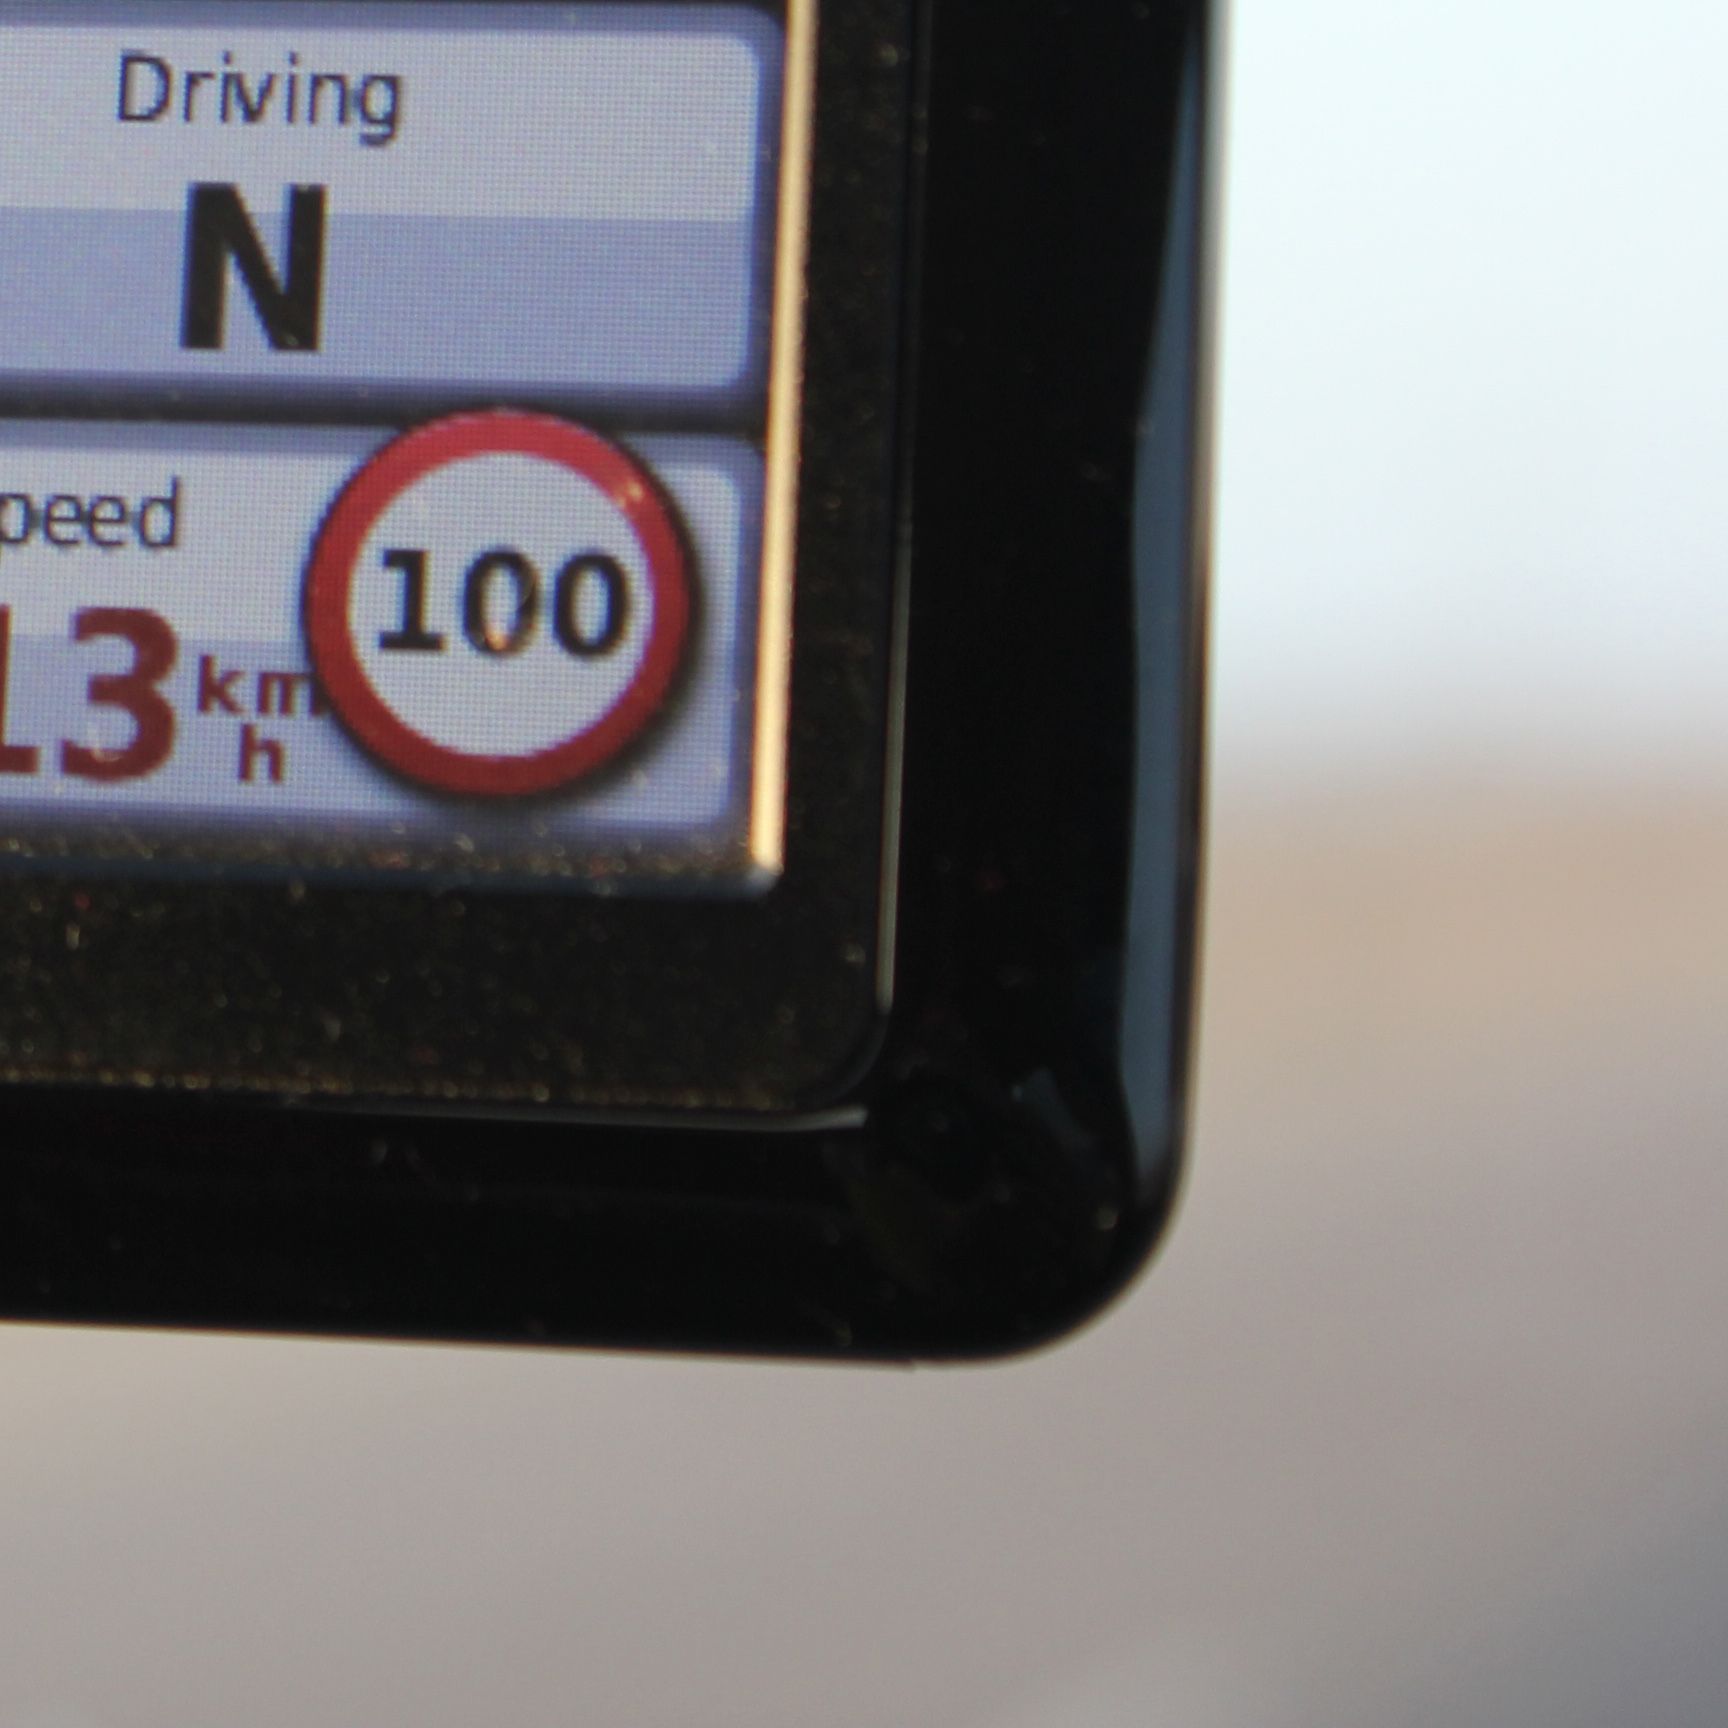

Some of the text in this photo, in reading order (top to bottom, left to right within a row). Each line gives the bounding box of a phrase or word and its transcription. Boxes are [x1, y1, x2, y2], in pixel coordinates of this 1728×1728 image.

[117, 50, 403, 146] Driving
[178, 182, 327, 353] N
[377, 548, 632, 658] 100
